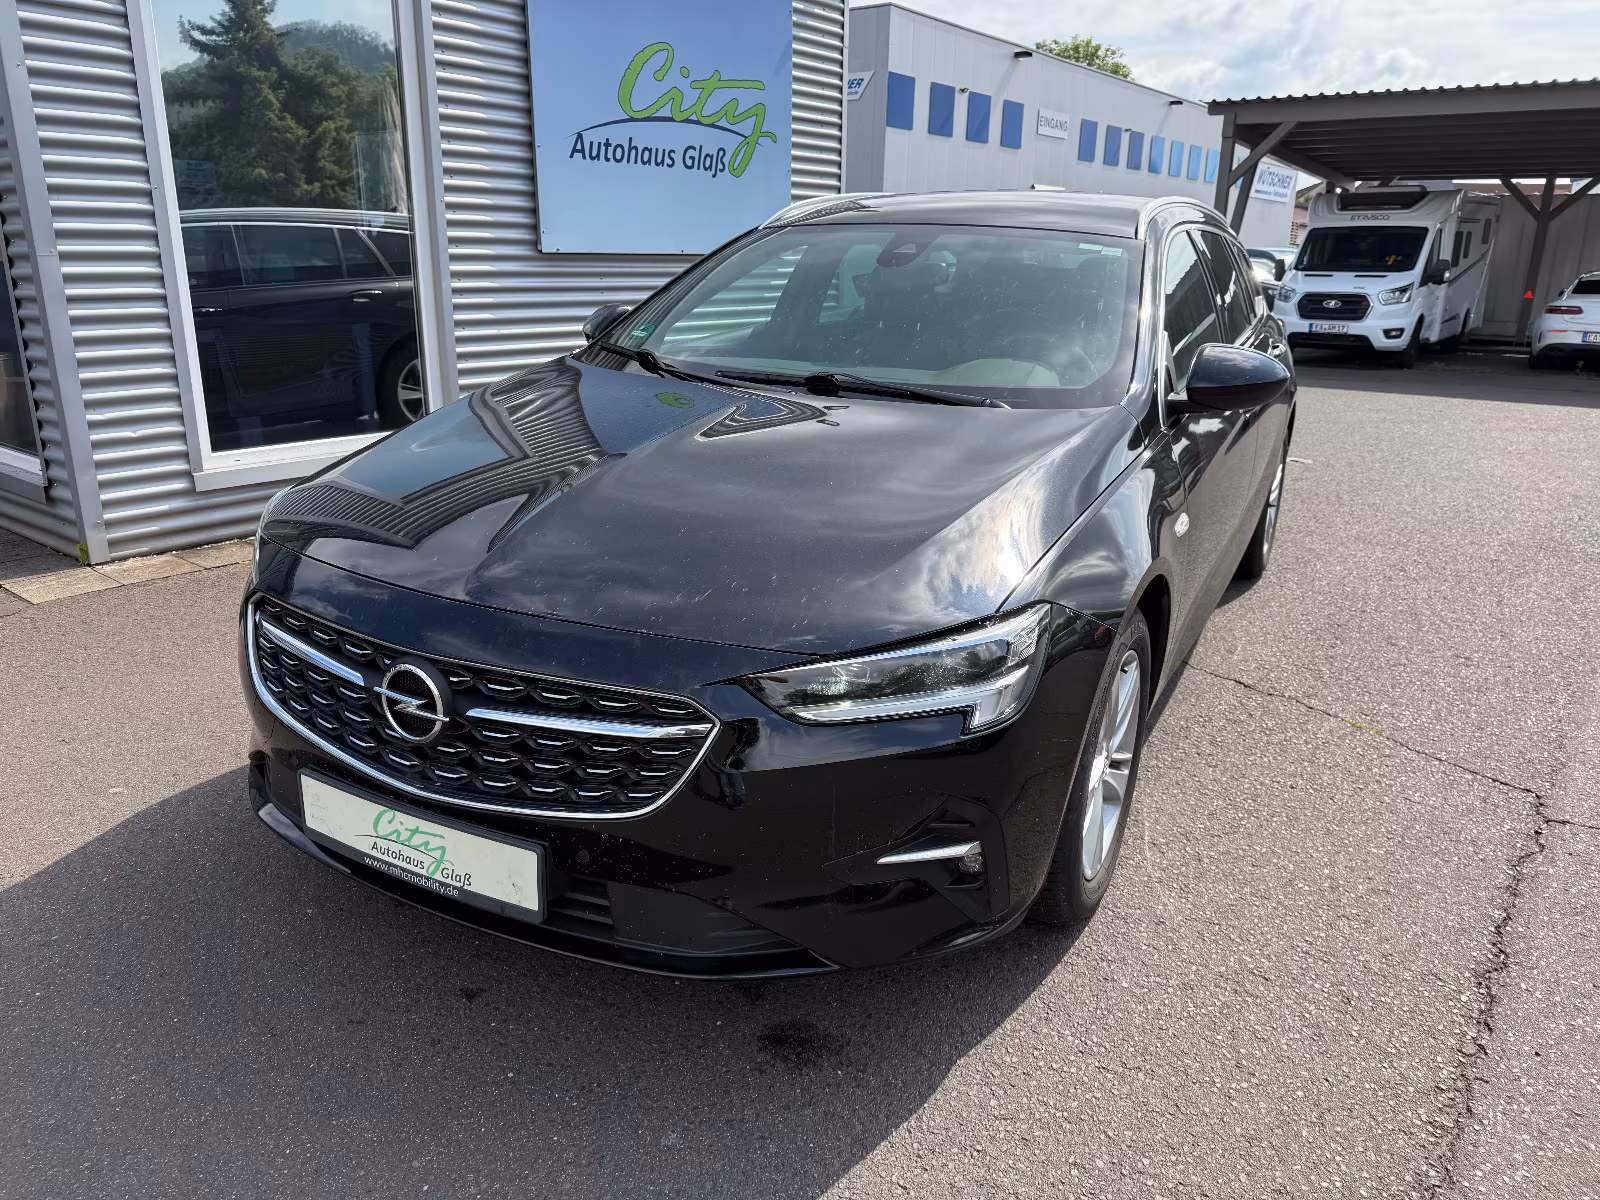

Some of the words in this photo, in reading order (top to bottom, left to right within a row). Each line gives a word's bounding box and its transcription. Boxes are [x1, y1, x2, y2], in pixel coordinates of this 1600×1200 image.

[618, 42, 777, 178] City
[1040, 115, 1068, 131] EINGANG
[569, 132, 675, 168] Autohaus
[682, 145, 726, 178] Glaß
[371, 841, 425, 870] Autohaus
[441, 867, 472, 887] Glaß
[373, 808, 454, 877] City
[364, 856, 459, 897] www.mhcmobility.de
